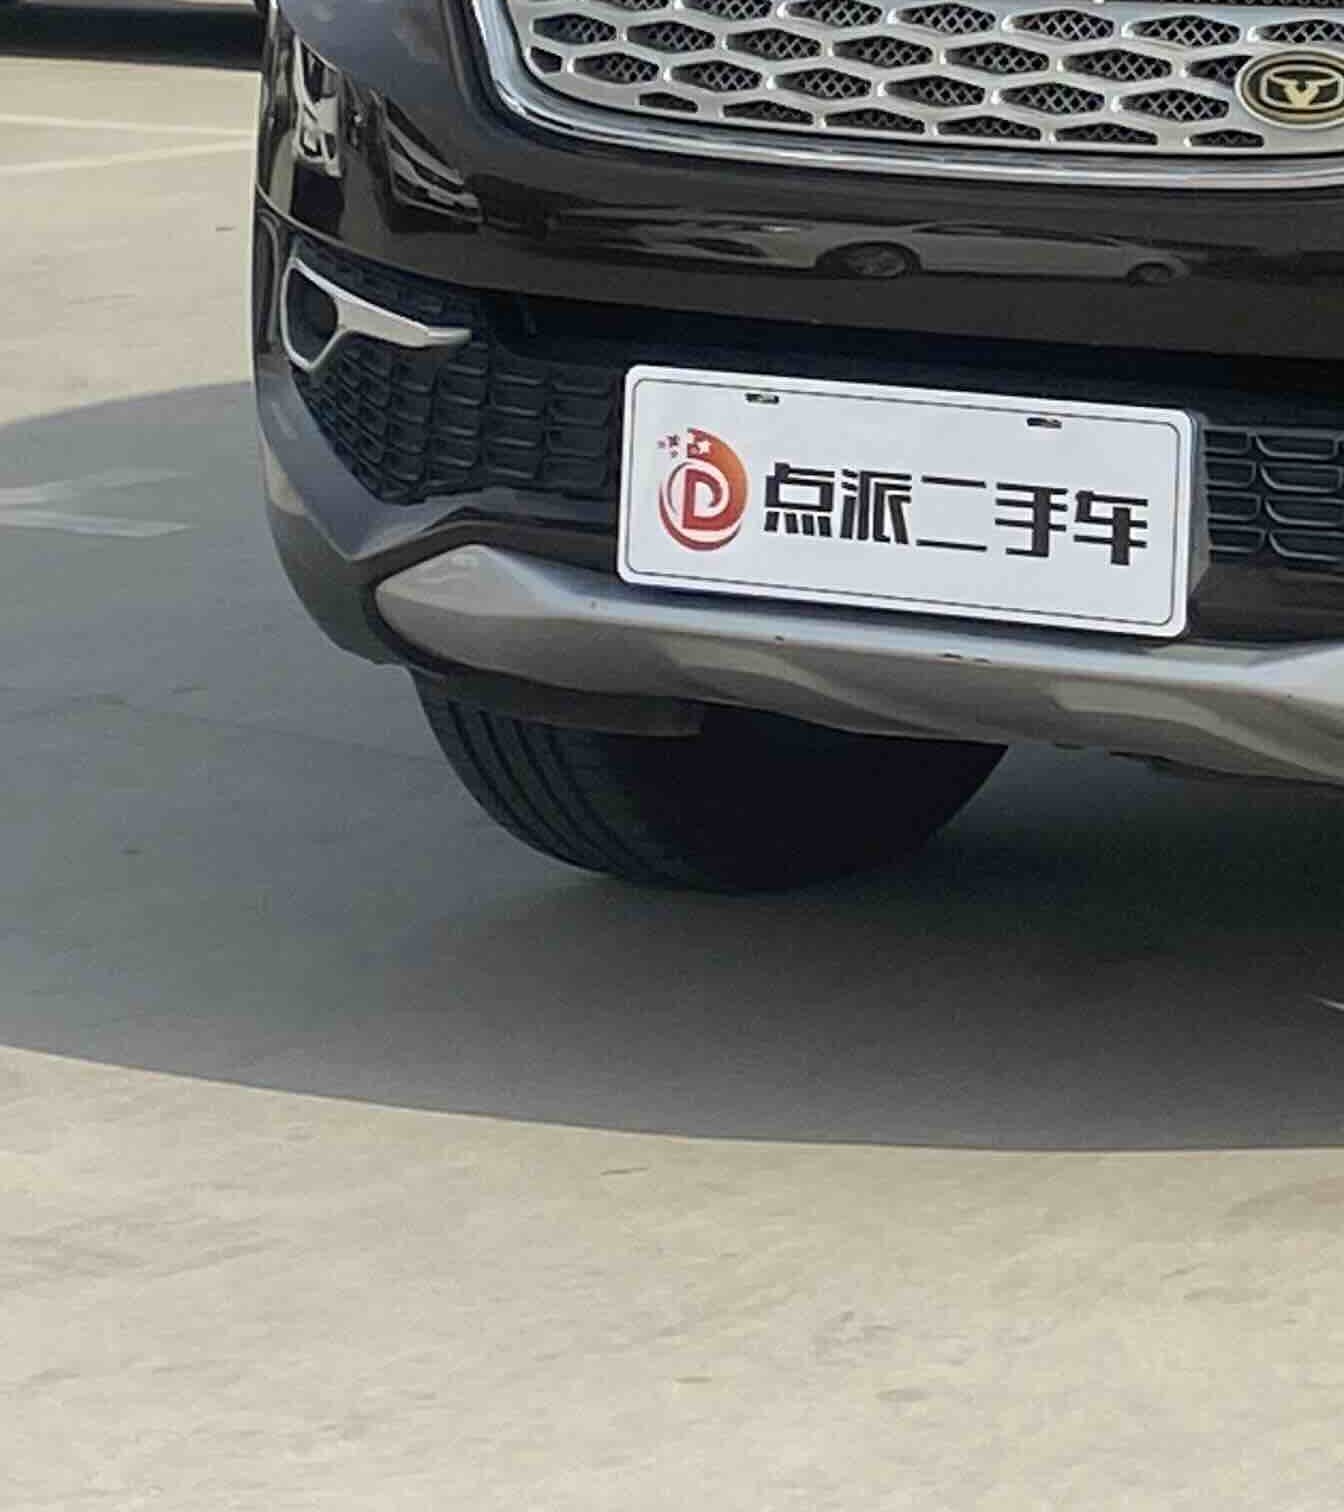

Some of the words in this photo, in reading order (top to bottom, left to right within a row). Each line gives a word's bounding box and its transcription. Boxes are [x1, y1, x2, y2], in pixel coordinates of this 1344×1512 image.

[763, 461, 1148, 566] 点派二手车
